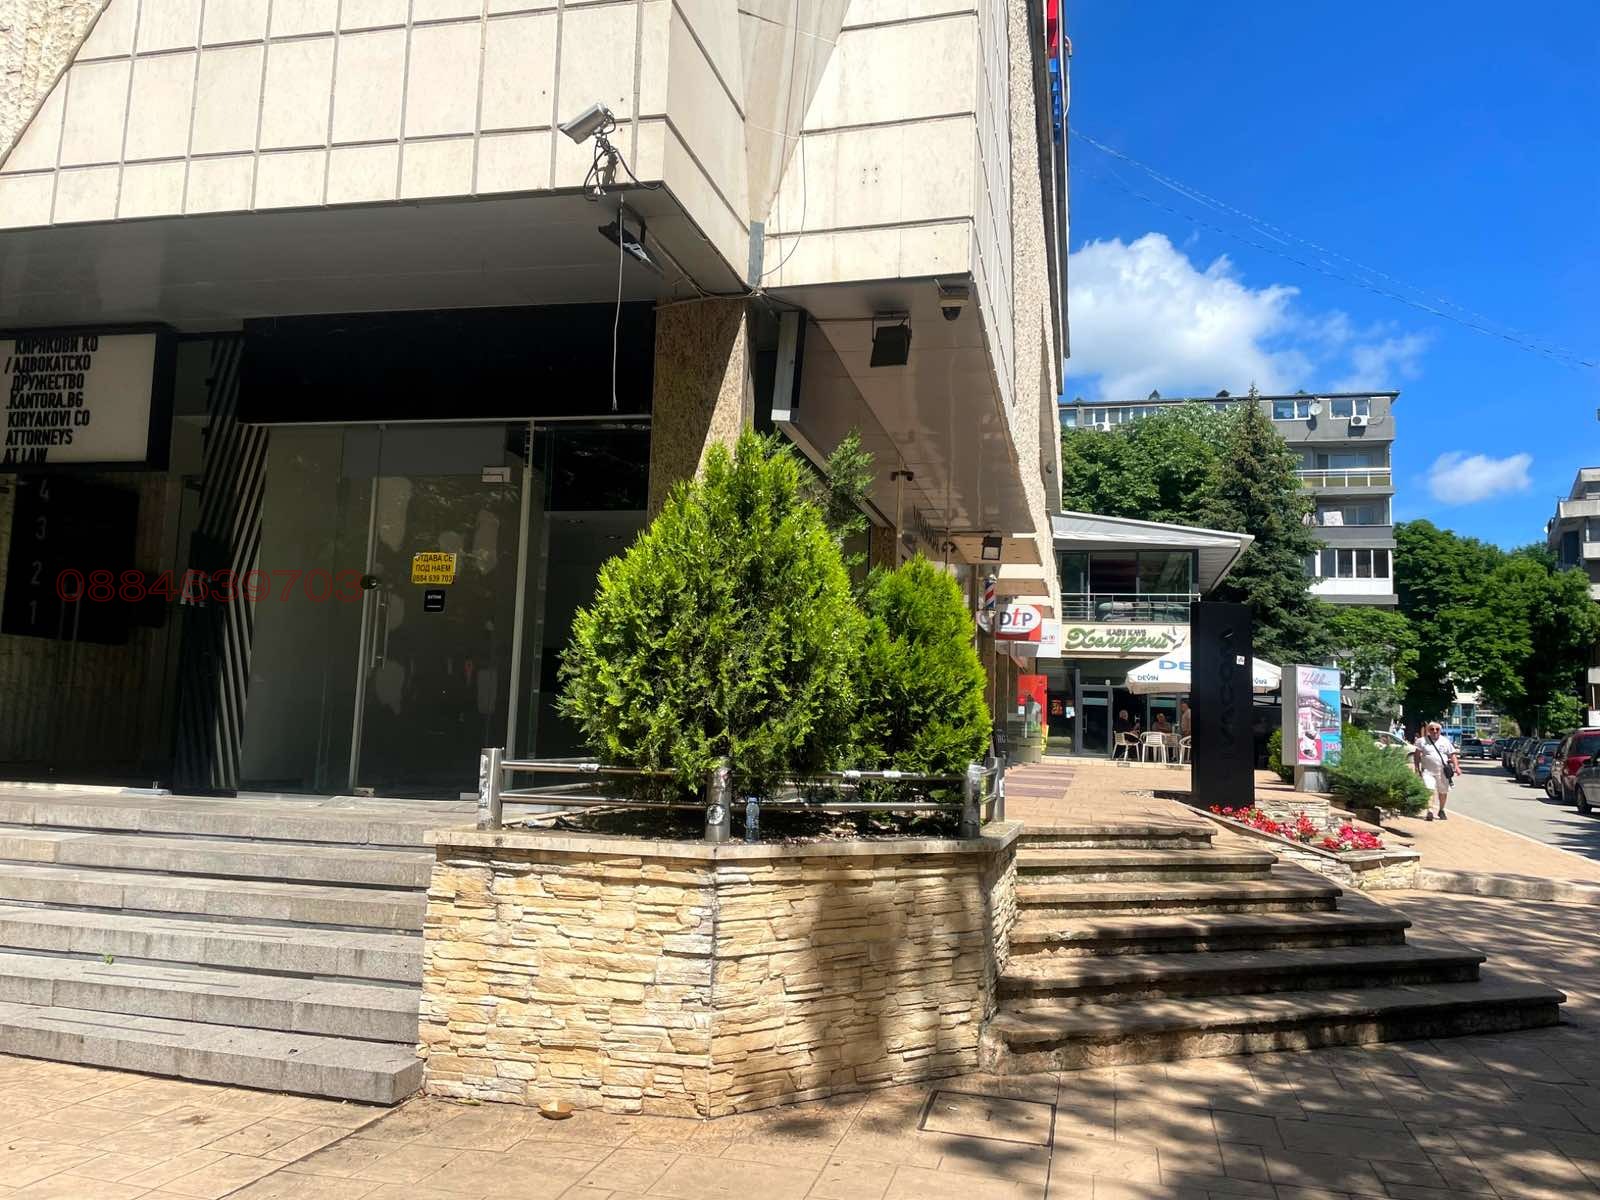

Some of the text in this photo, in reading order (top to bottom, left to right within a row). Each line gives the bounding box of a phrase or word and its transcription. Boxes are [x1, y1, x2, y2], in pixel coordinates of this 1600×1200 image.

[12, 355, 91, 373] АДВОКАТСКО
[11, 373, 85, 391] ДРУЖЕСТВО
[7, 410, 90, 427] KIRYAKOVI CO
[5, 429, 73, 446] ATTORNEYS
[3, 448, 49, 464] AT LAW
[40, 479, 49, 498] 4
[35, 516, 47, 540] 3
[30, 560, 42, 584] 2
[416, 564, 430, 572] ПОД
[29, 600, 37, 624] 1
